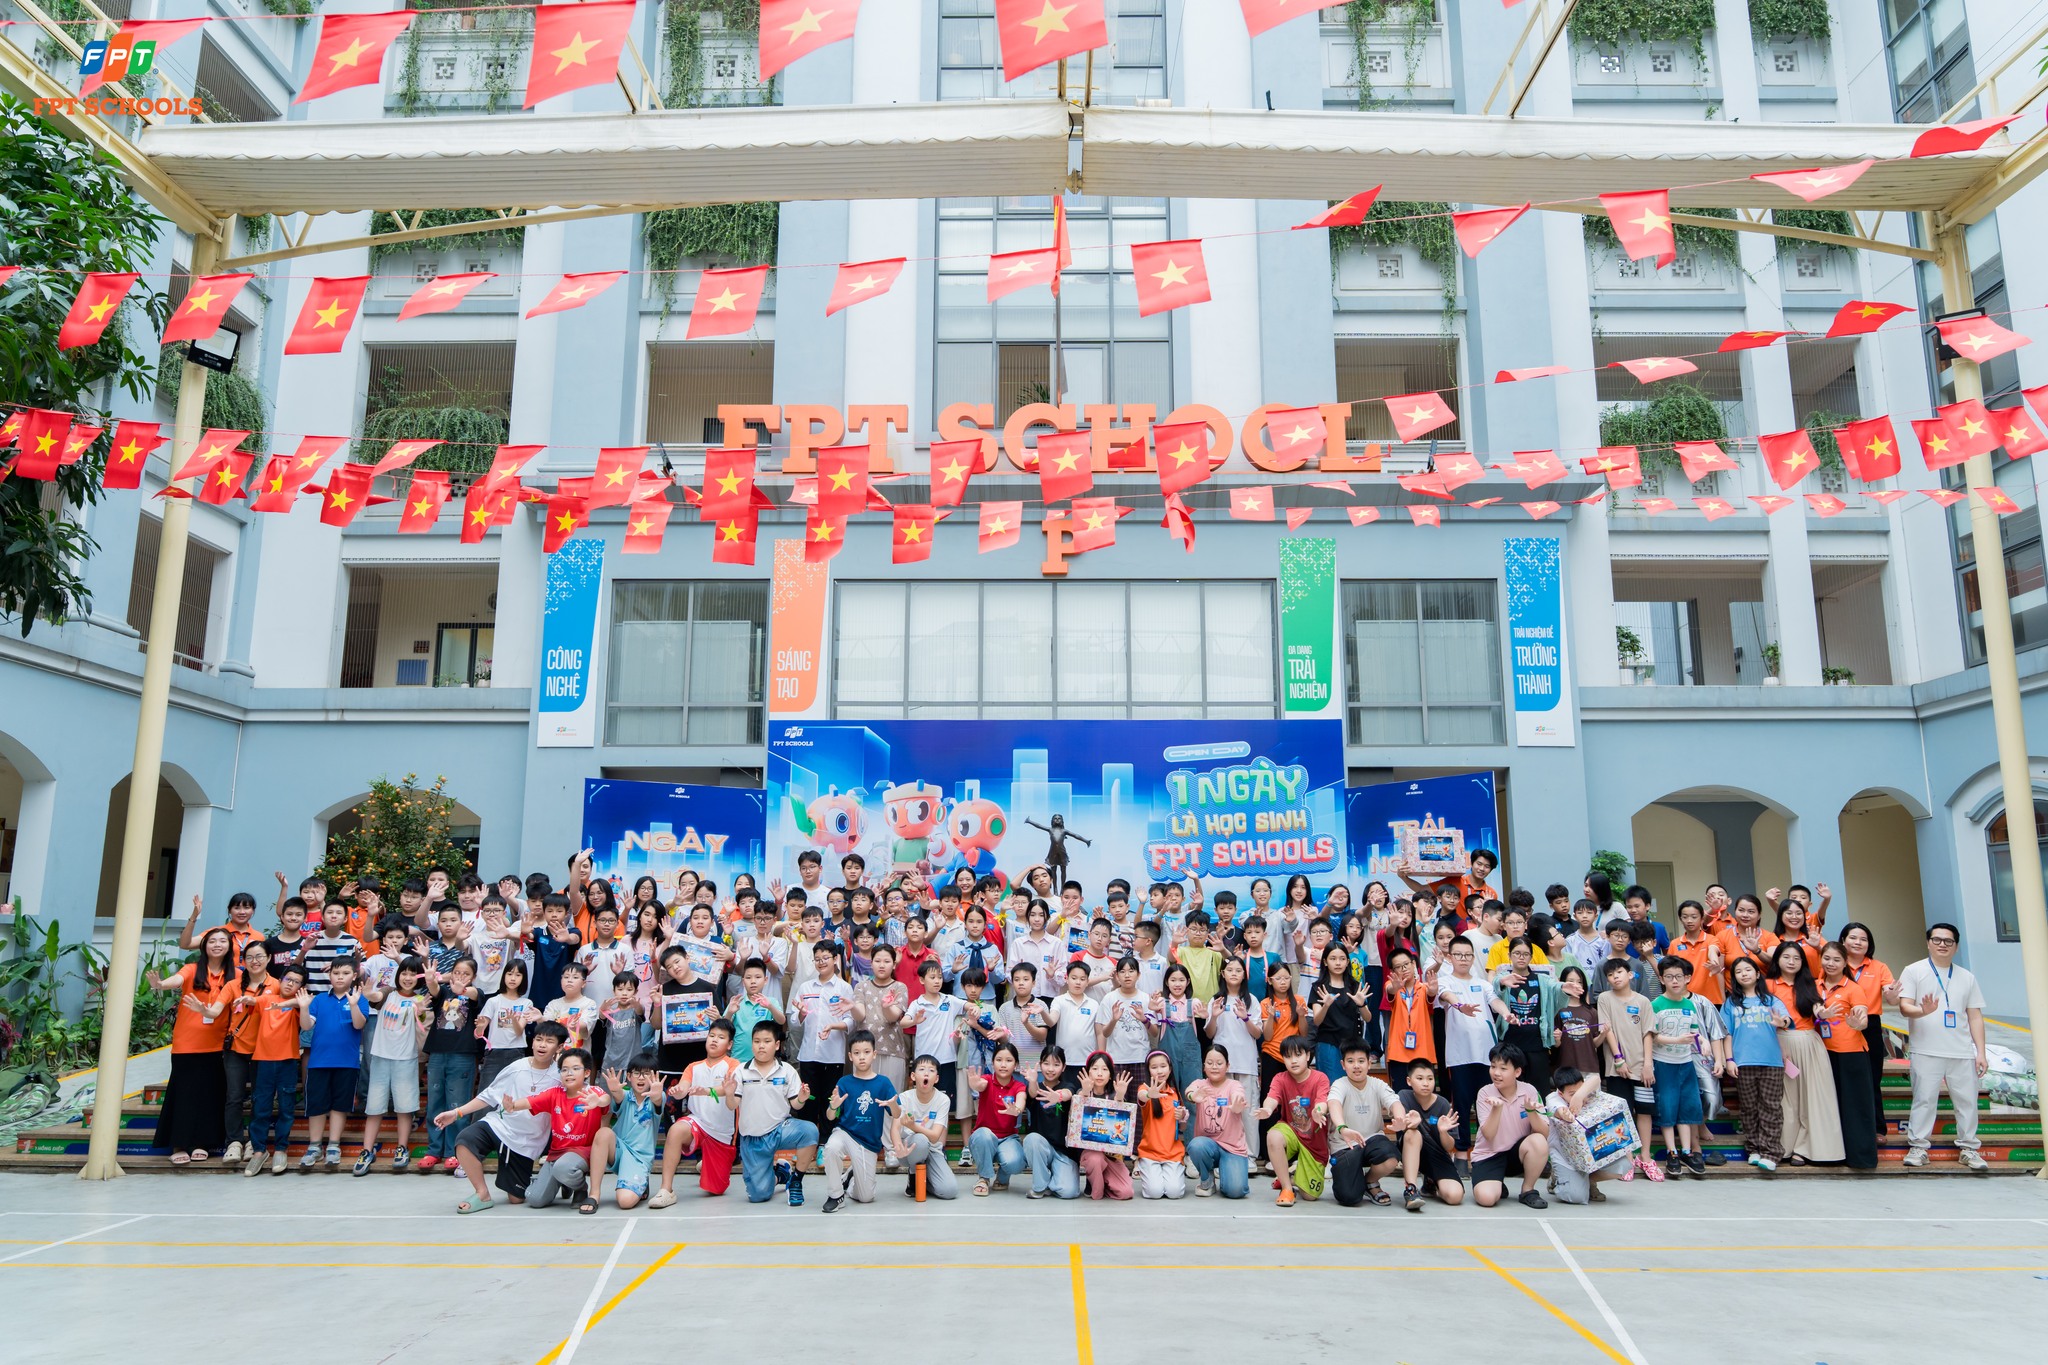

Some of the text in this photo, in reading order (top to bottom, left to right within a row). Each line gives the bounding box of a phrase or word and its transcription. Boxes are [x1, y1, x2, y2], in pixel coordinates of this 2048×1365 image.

[717, 404, 909, 473] FPT
[547, 646, 582, 670] CÔNG
[776, 647, 812, 671] SÁNG
[1515, 642, 1557, 667] TRƯỞNG
[1288, 655, 1316, 680] TRẢI
[546, 673, 581, 699] NGHỆ
[776, 677, 799, 700] TẠO
[1289, 680, 1327, 700] NGHIỆM
[1516, 670, 1552, 695] THÀNH
[1169, 746, 1245, 757] OPEN DAY
[1172, 761, 1301, 807] 1 NGÀY
[1172, 810, 1307, 839] LÀ HỌC SINH
[624, 827, 729, 853] NGÀY
[1148, 837, 1334, 870] FPT SCHOOLS
[22, 1140, 31, 1153] 1
[1309, 1178, 1322, 1192] 56
